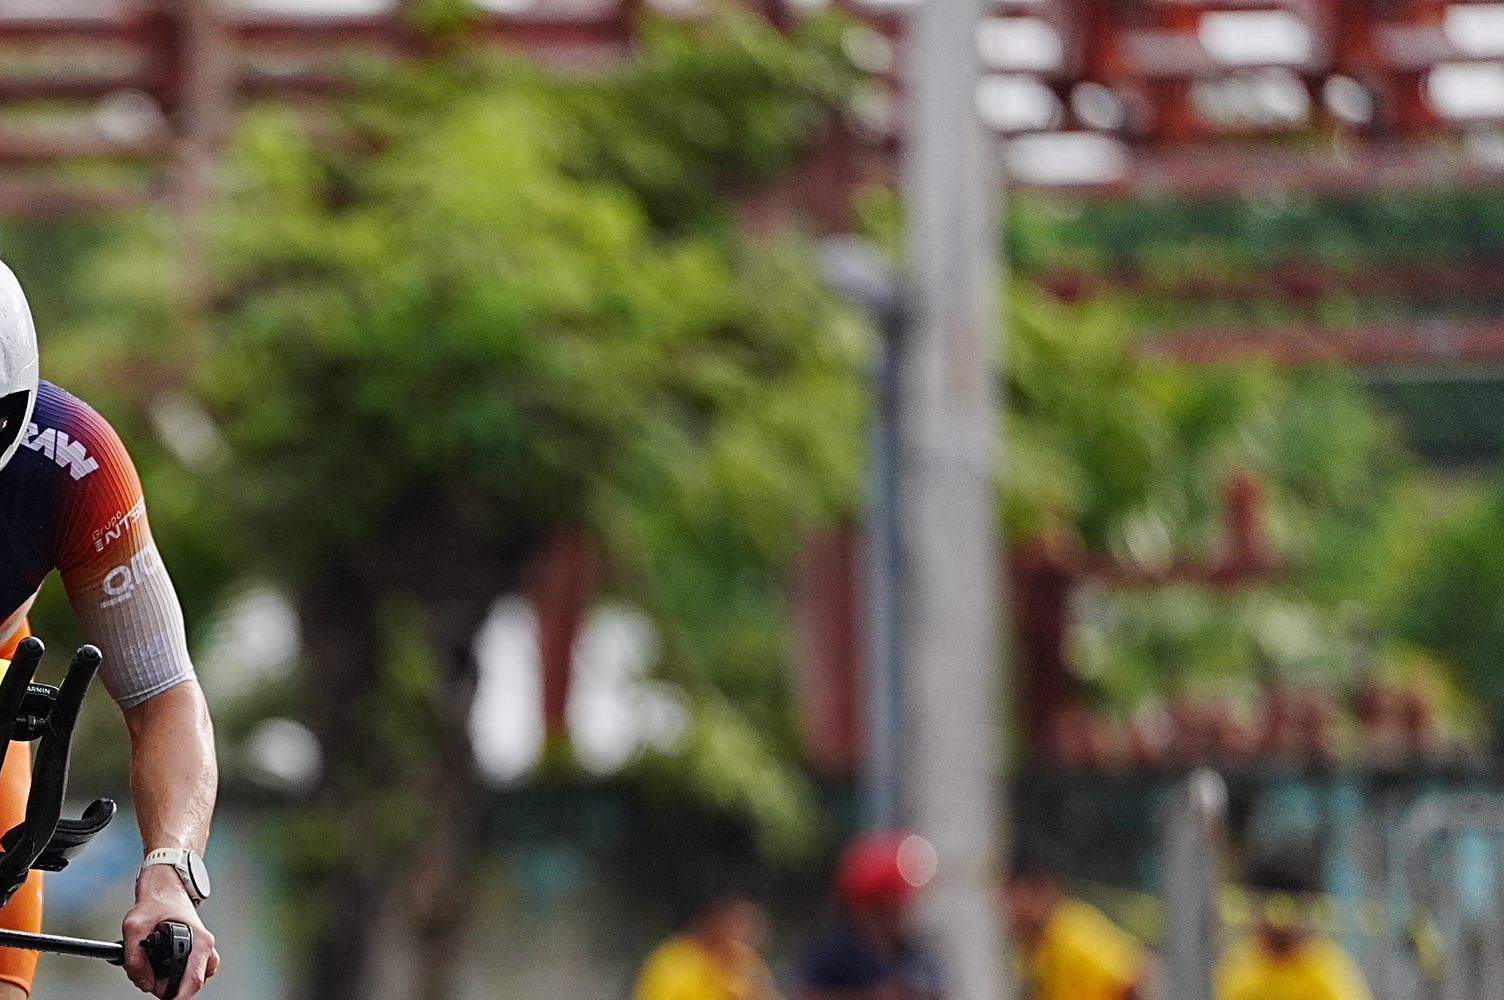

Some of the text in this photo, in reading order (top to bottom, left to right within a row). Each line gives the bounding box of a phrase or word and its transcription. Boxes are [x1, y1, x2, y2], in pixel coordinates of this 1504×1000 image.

[20, 421, 100, 481] RAW
[91, 510, 122, 541] Grupo
[26, 685, 51, 695] ARMIN
